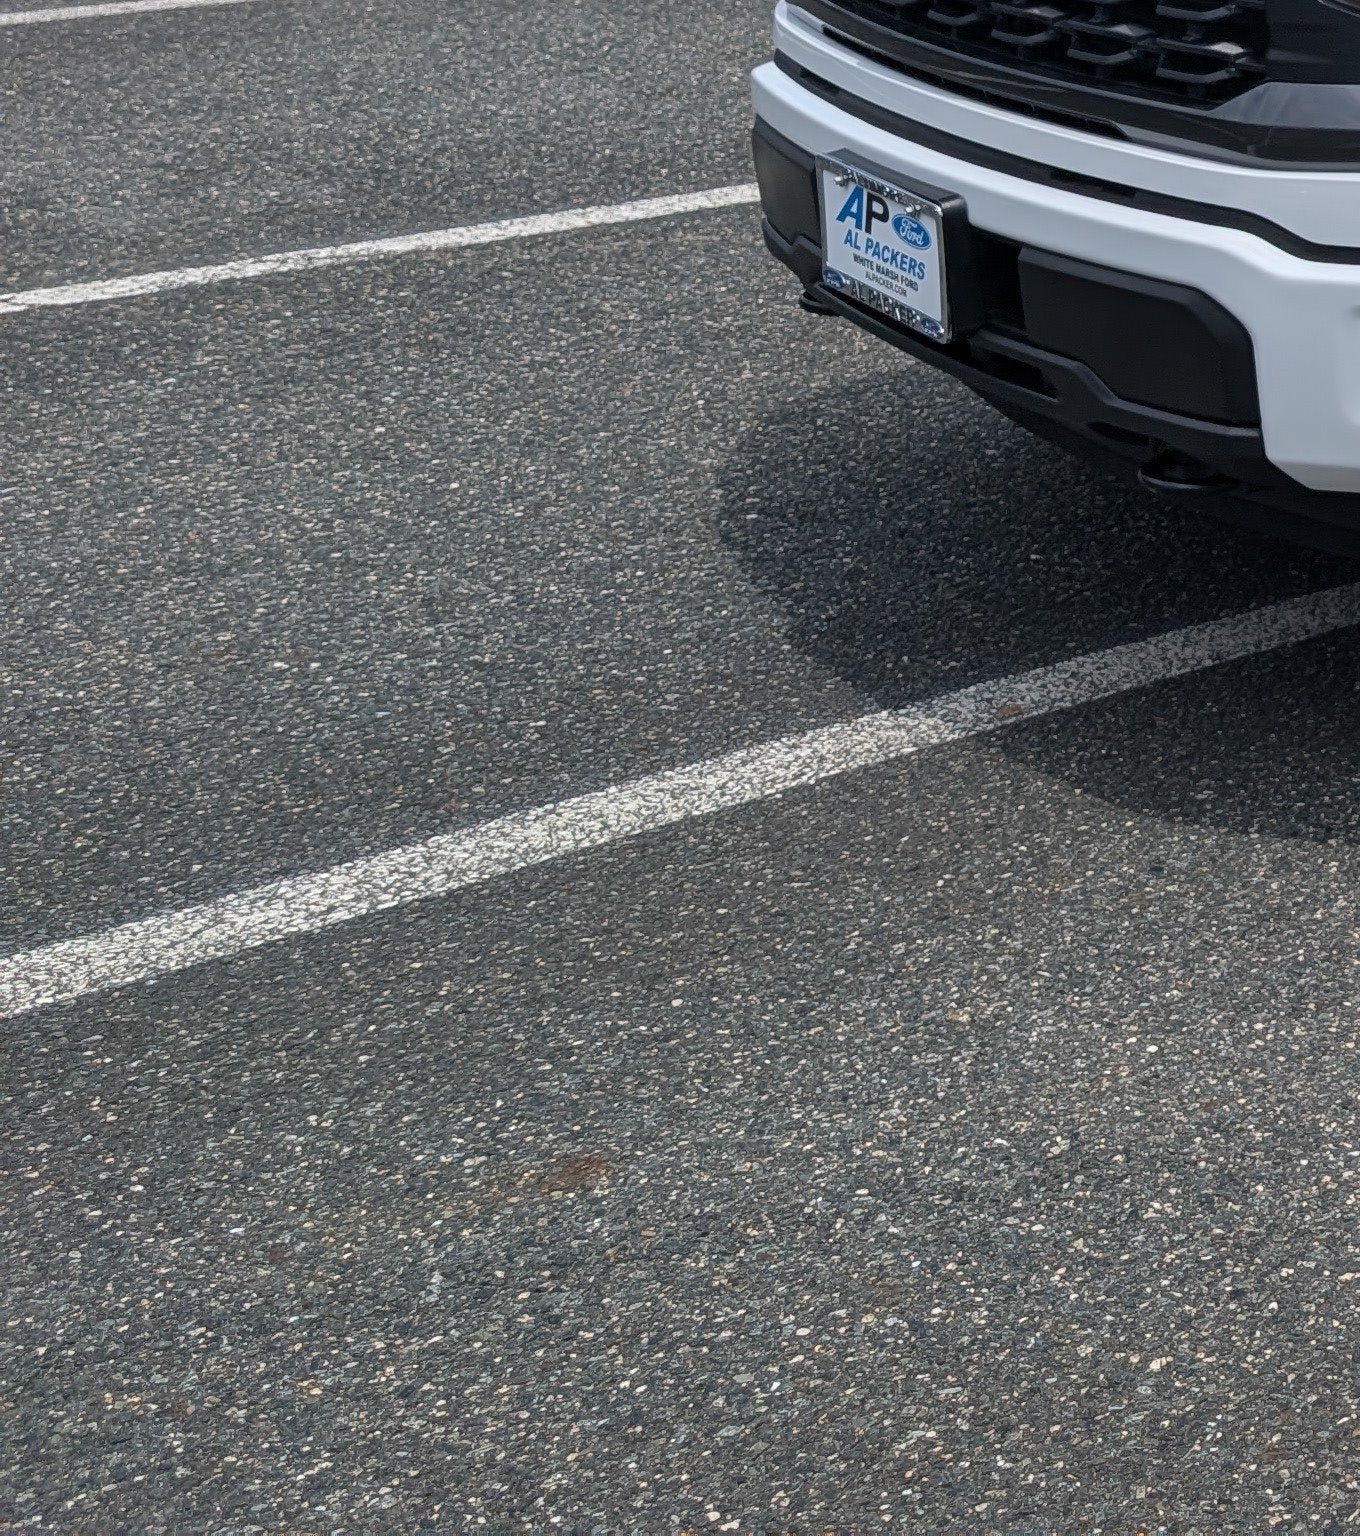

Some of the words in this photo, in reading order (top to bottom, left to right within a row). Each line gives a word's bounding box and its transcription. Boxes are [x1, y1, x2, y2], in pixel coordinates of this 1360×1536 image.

[836, 185, 890, 234] AP
[900, 218, 924, 246] Ford
[843, 229, 861, 251] AL
[864, 237, 926, 280] PACKERS
[853, 253, 875, 273] WHITE
